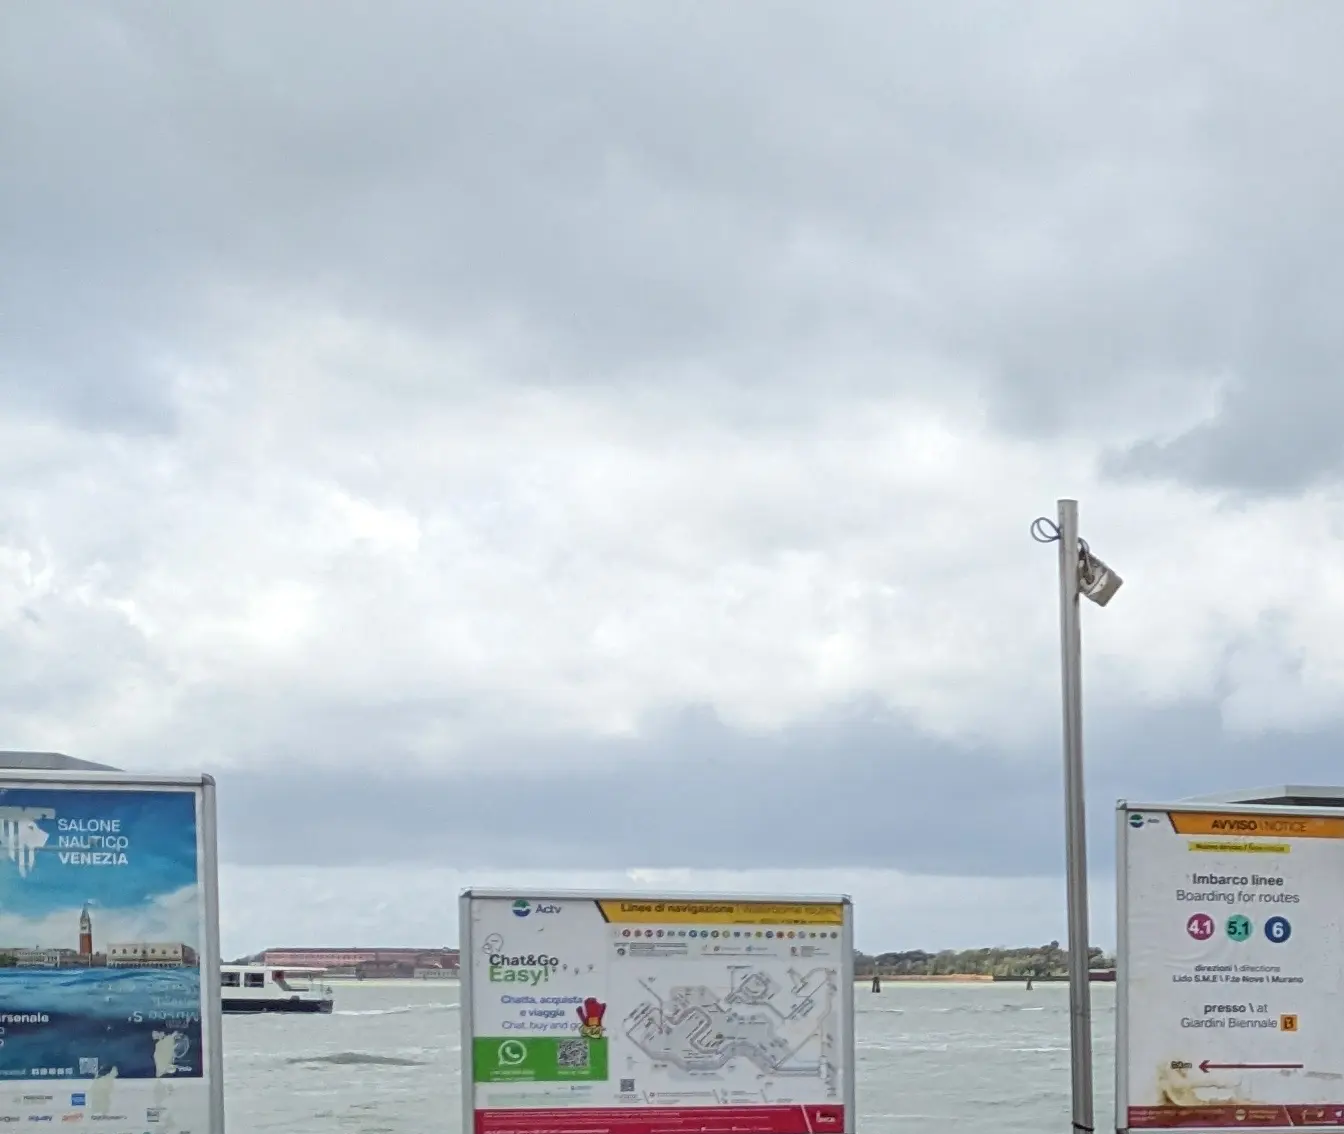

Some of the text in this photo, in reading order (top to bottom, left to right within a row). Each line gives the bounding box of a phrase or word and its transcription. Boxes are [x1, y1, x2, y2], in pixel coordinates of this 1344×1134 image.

[58, 819, 121, 832] SALONE
[1211, 820, 1258, 831] AVVISO
[58, 836, 129, 849] NAUTICO
[58, 853, 129, 865] VENEZIA
[1192, 873, 1284, 886] Imbarco linee
[1176, 890, 1300, 904] Boarding for routes
[535, 904, 562, 914] Actv
[1188, 919, 1284, 937] 4.1 5.1 6
[489, 954, 559, 966] Chat&Go
[489, 966, 549, 986] Easy!
[529, 1008, 565, 1018] viaggia
[1204, 1004, 1246, 1014] presso
[1257, 1004, 1268, 1013] at
[0, 1012, 50, 1023] rsenale
[1181, 1017, 1225, 1028] Giardini
[1229, 1018, 1277, 1028] Biennale
[530, 1020, 548, 1031] buy
[550, 1021, 568, 1030] and
